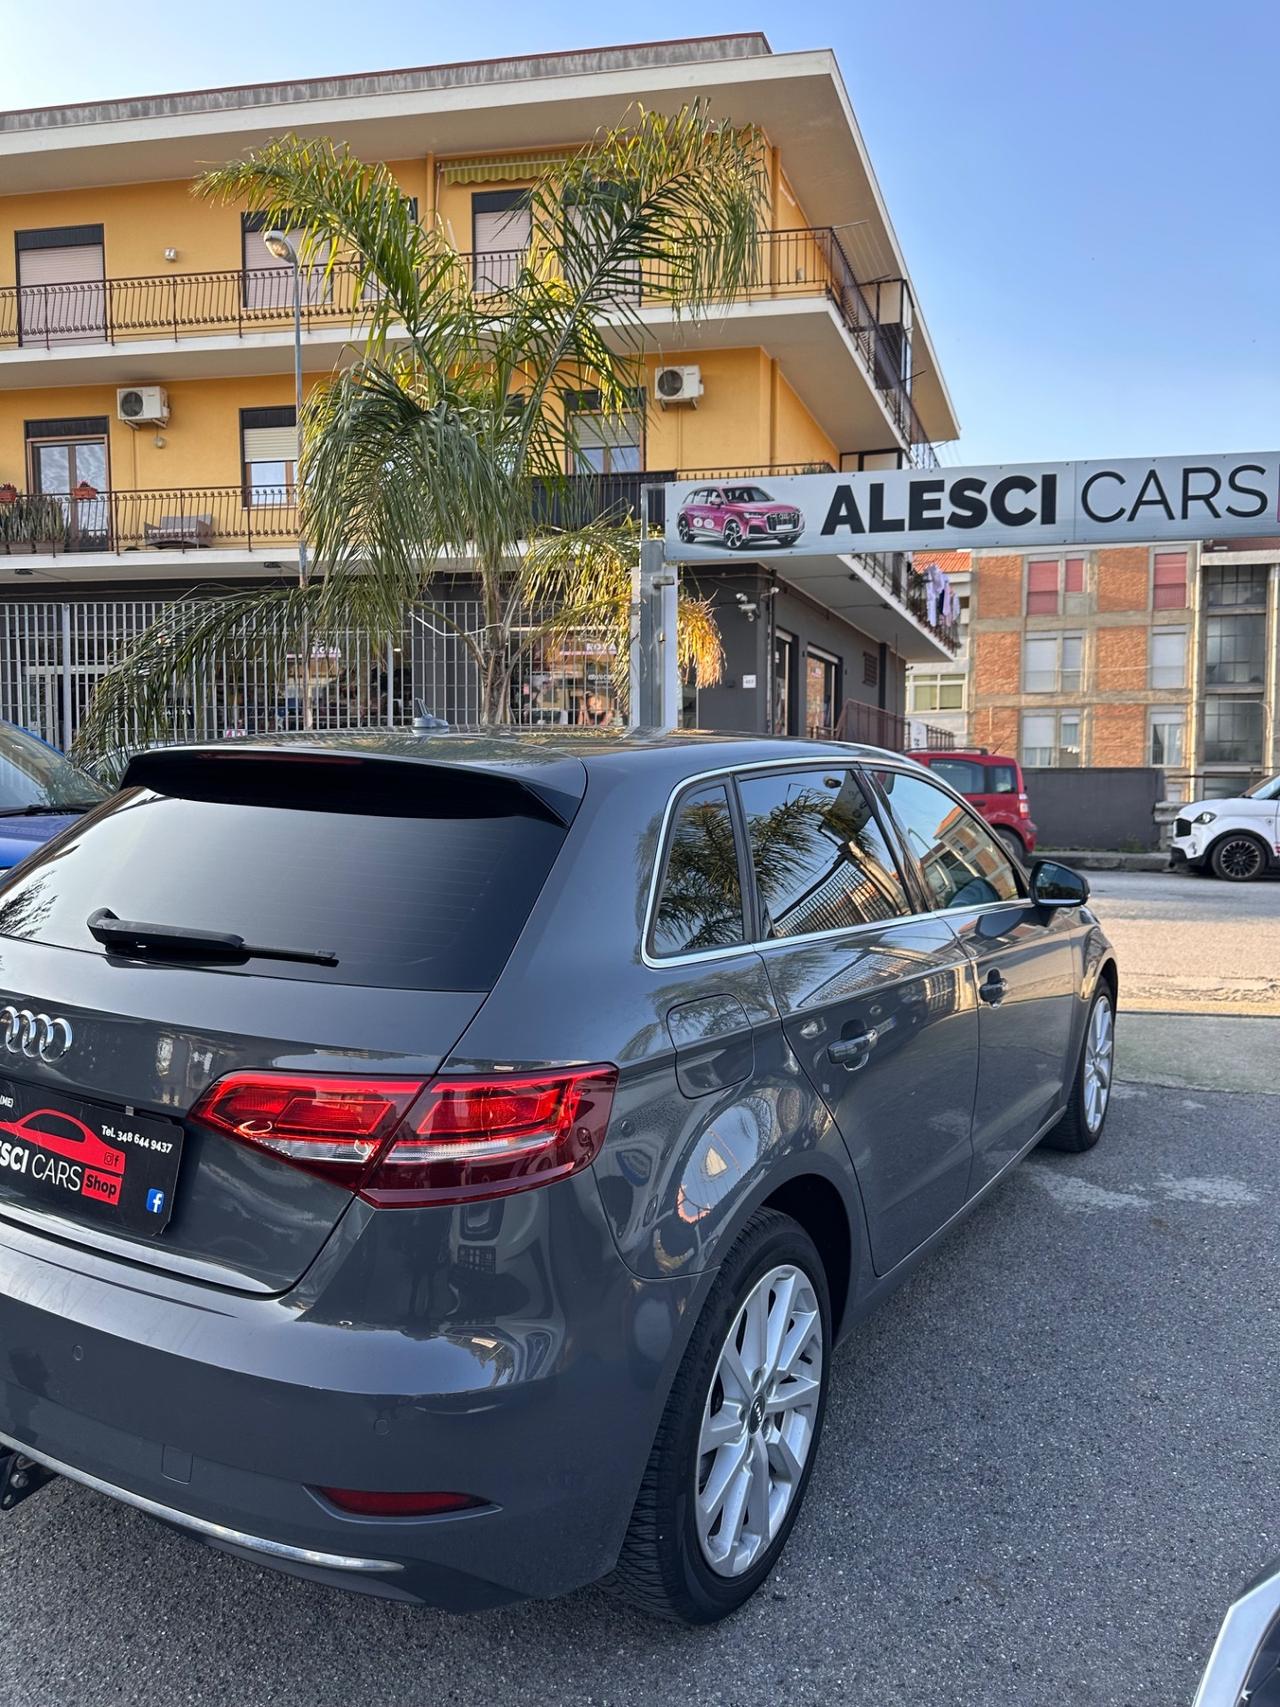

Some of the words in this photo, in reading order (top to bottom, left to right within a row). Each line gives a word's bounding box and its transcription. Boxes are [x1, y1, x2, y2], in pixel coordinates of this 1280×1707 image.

[820, 473, 1057, 536] ALESCI
[1081, 464, 1268, 523] CARS
[116, 1130, 133, 1143] 348
[133, 1133, 150, 1149] 644
[150, 1139, 173, 1154] 9437
[0, 1140, 29, 1173] SCI
[32, 1153, 82, 1191] CARS
[85, 1173, 117, 1199] Shop
